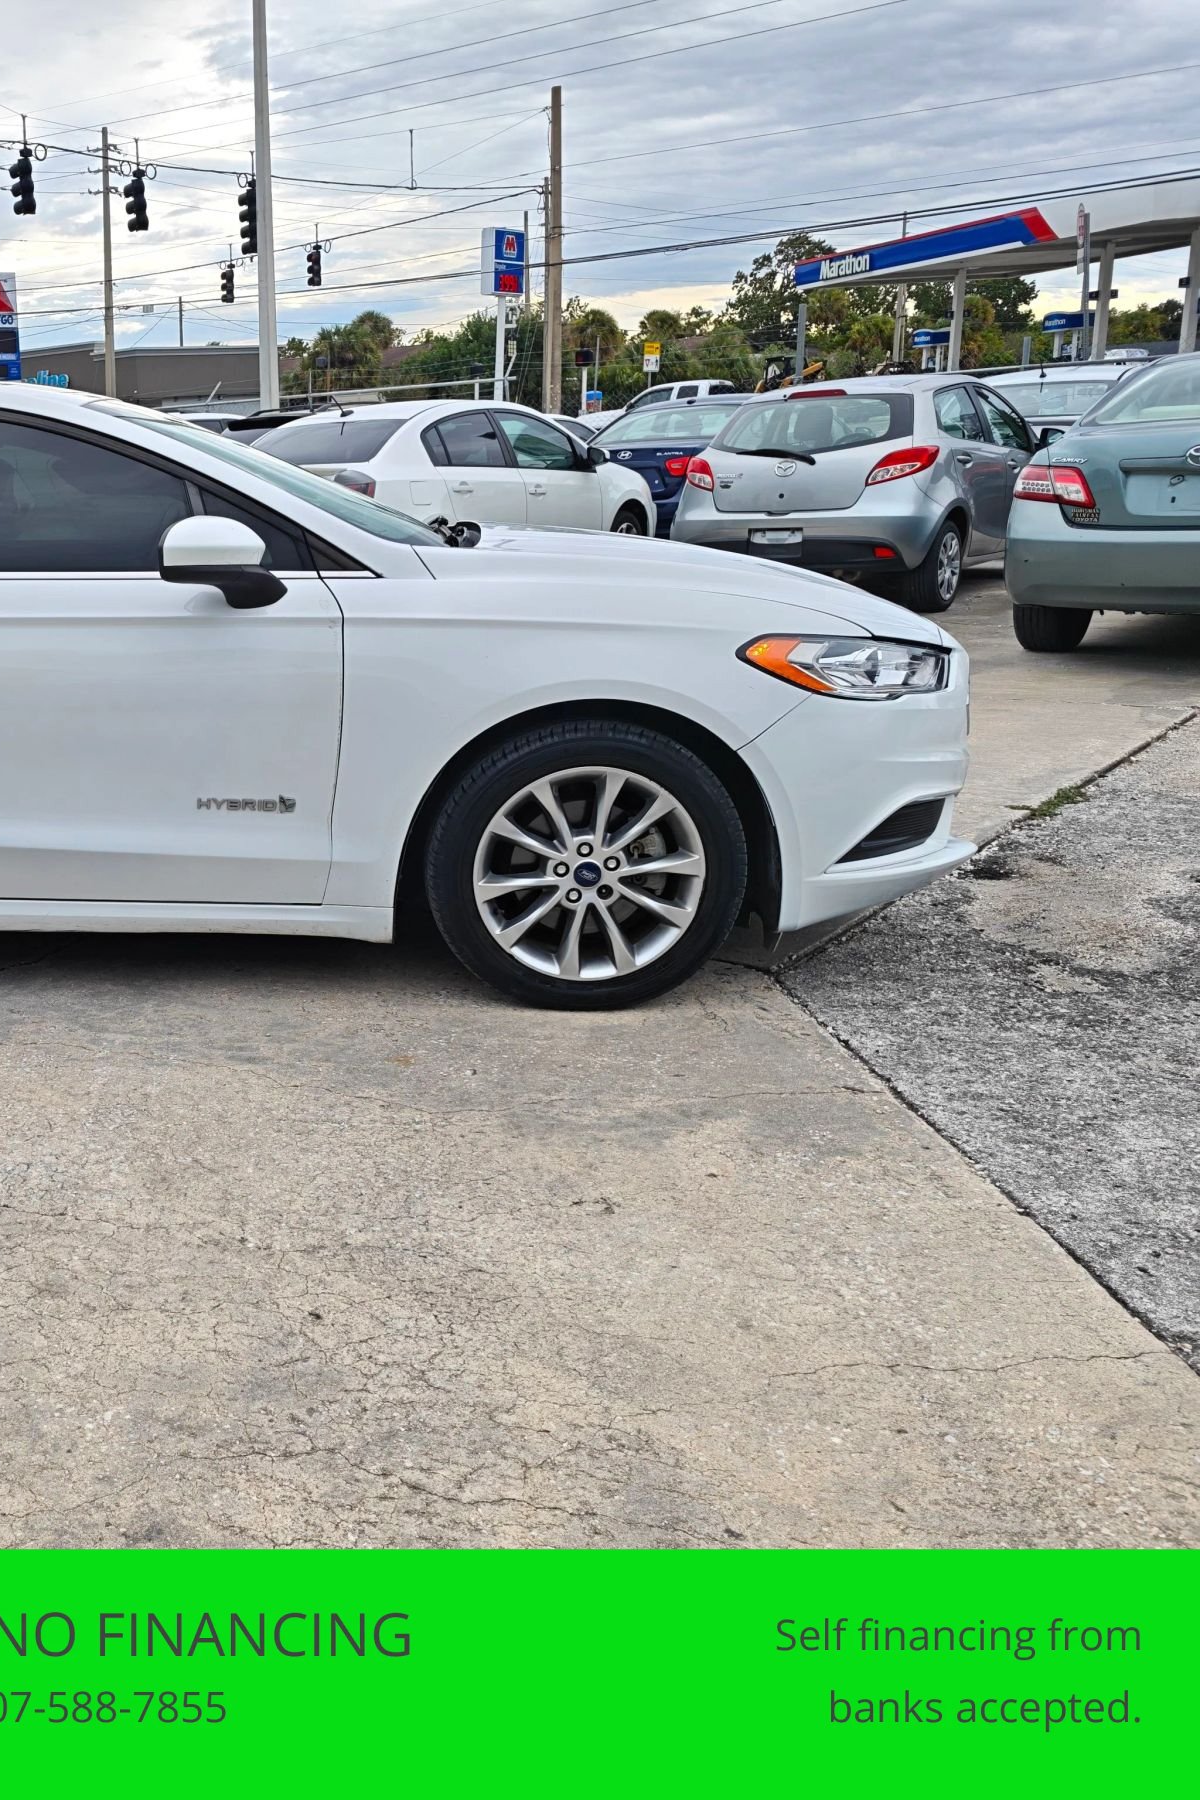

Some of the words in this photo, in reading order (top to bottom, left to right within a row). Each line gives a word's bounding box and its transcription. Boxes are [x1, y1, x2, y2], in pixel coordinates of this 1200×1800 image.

[820, 253, 870, 281] Marathon
[1044, 318, 1066, 327] Marathon
[197, 797, 278, 812] HYBRID
